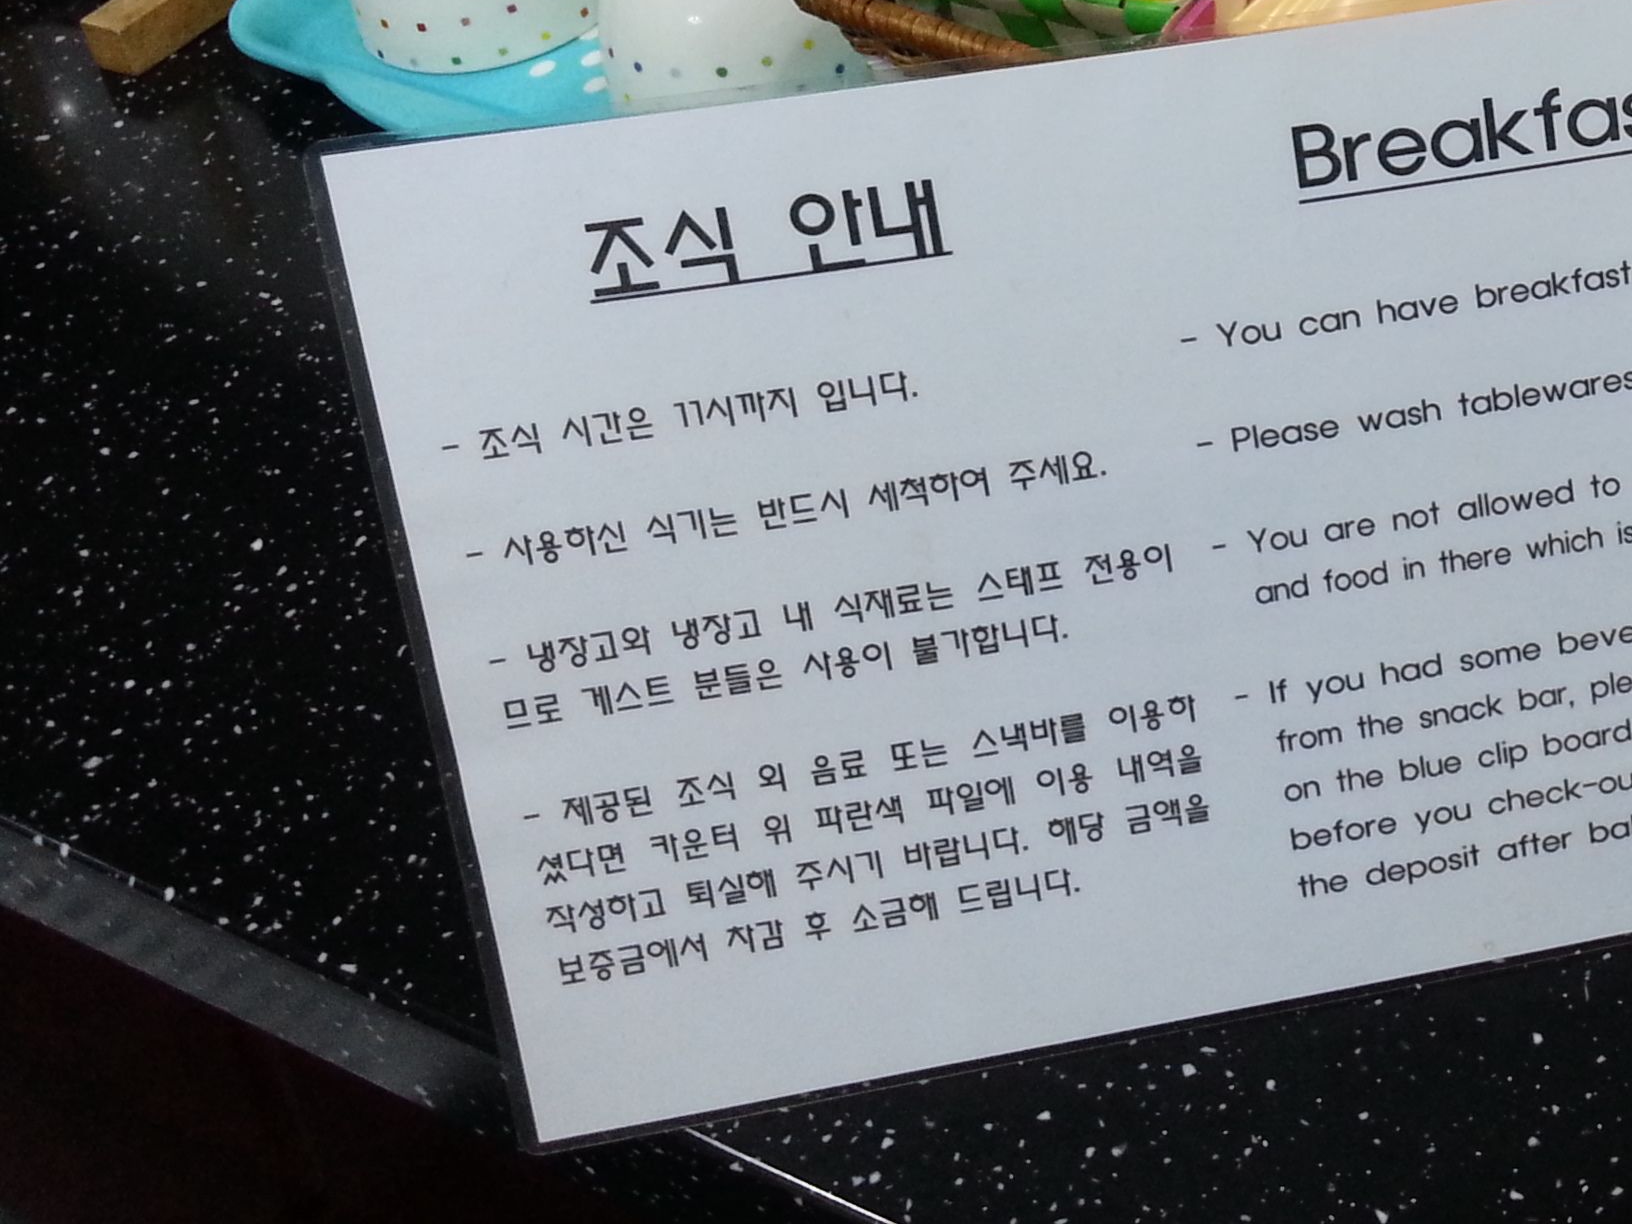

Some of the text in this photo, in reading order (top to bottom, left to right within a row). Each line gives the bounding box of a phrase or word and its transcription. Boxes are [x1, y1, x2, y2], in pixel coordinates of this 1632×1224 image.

[583, 178, 944, 298] 조식 안내
[1215, 321, 1282, 348] You
[1298, 309, 1361, 337] can
[1376, 294, 1459, 324] have
[1474, 260, 1631, 309] breakfast
[478, 422, 543, 460] 조식
[562, 407, 654, 447] 시간은
[673, 386, 798, 428] 11시까지
[816, 371, 918, 413] 입니다.
[1231, 419, 1340, 452] Please
[1357, 398, 1442, 433] wash
[503, 520, 628, 566] 사용하신
[646, 507, 738, 545] 식기는
[757, 488, 850, 531] 반드시
[868, 466, 991, 512] 세척하여
[1008, 450, 1107, 491] 주세요.
[1246, 527, 1309, 553] You
[1323, 518, 1376, 543] are
[1392, 501, 1440, 532] not
[1457, 478, 1575, 521] allowed
[1589, 474, 1621, 499] to
[526, 625, 652, 674] 냉장고와
[671, 609, 762, 650] 냉장고
[782, 600, 814, 632] 내
[834, 581, 954, 624] 식재료는
[977, 560, 1063, 602] 스태프
[1084, 543, 1173, 586] 전용이
[1255, 573, 1310, 605] and
[1322, 559, 1389, 594] food
[1402, 556, 1426, 581] in
[1438, 546, 1512, 574] there
[1525, 526, 1604, 560] which
[503, 613, 1068, 730] 므로 게스트 분들은 사용이 불가합니다.
[1268, 678, 1287, 704] If
[1305, 671, 1365, 705] you
[1379, 652, 1443, 686] had
[1459, 642, 1541, 673] some
[561, 785, 654, 826] 제공된
[676, 771, 737, 808] 조식
[758, 762, 787, 792] 외
[810, 749, 868, 787] 음료
[890, 739, 948, 772] 또는
[972, 712, 1086, 759] 스낵바를
[1108, 694, 1196, 734] 이용하
[1275, 726, 1343, 753] from
[1356, 714, 1404, 740] the
[1419, 693, 1504, 730] snack
[1517, 686, 1575, 712] bar,
[1284, 780, 1321, 802] on
[1335, 768, 1384, 793] the
[1398, 754, 1462, 783] blue
[1477, 740, 1528, 770] clip
[1541, 718, 1632, 757] board
[536, 744, 1202, 886] 셨다면 카운터 위 파란색 파일에 이용 내역을
[1289, 816, 1397, 851] before
[1414, 802, 1472, 835] you
[546, 793, 1209, 934] 작성하고 퇴실해 주시기 바랍니다. 해당 금액을
[1297, 873, 1349, 898] the
[1365, 844, 1480, 886] deposit
[1497, 831, 1572, 862] after
[558, 868, 1081, 986] 보증금에서 차감 후 소금해 드립니다.
